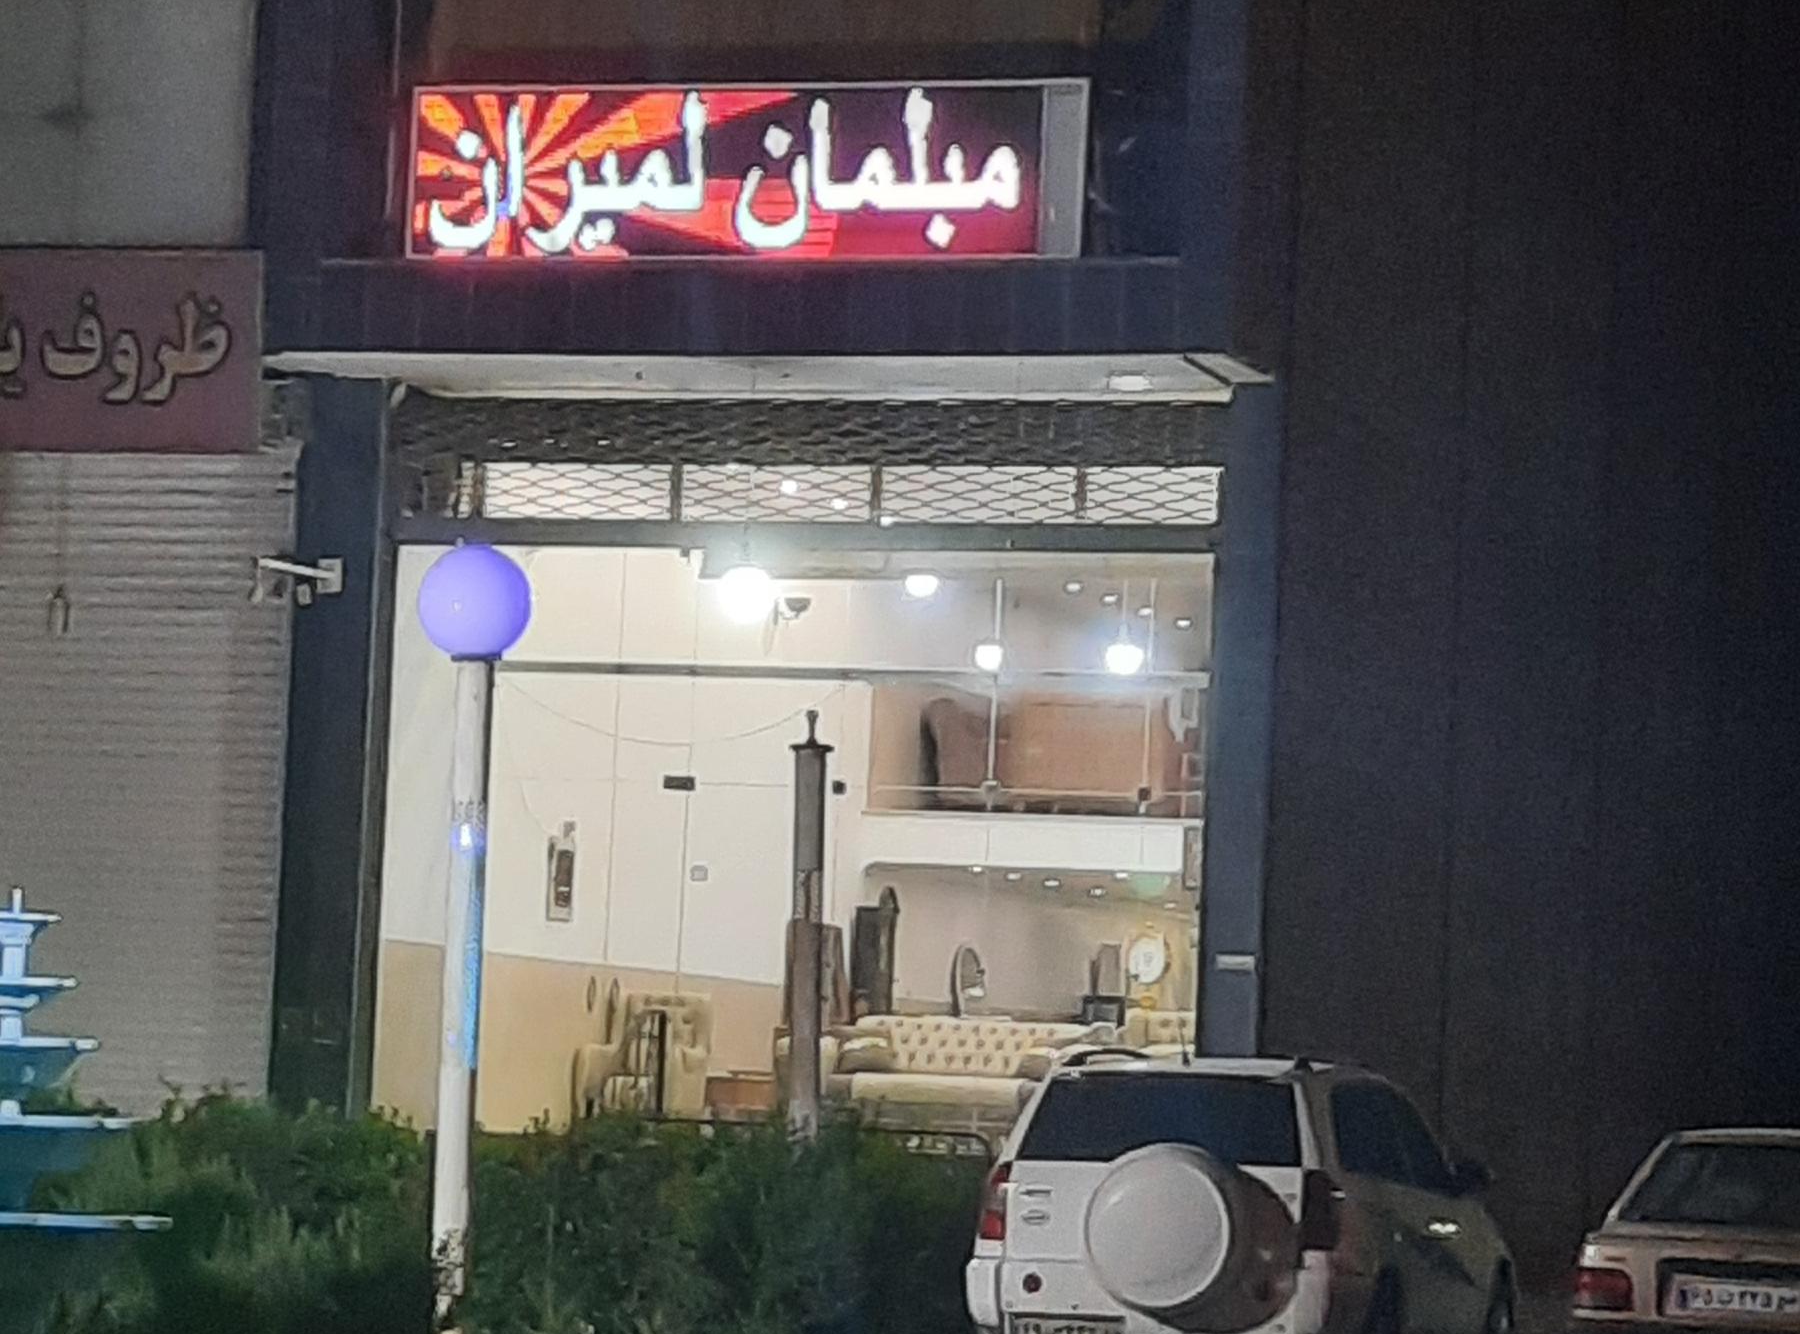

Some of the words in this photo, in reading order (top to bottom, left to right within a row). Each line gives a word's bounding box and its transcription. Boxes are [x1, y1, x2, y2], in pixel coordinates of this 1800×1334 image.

[428, 89, 707, 254] لمیران
[733, 87, 1020, 249] مبلمان
[39, 289, 233, 406] ظروف
